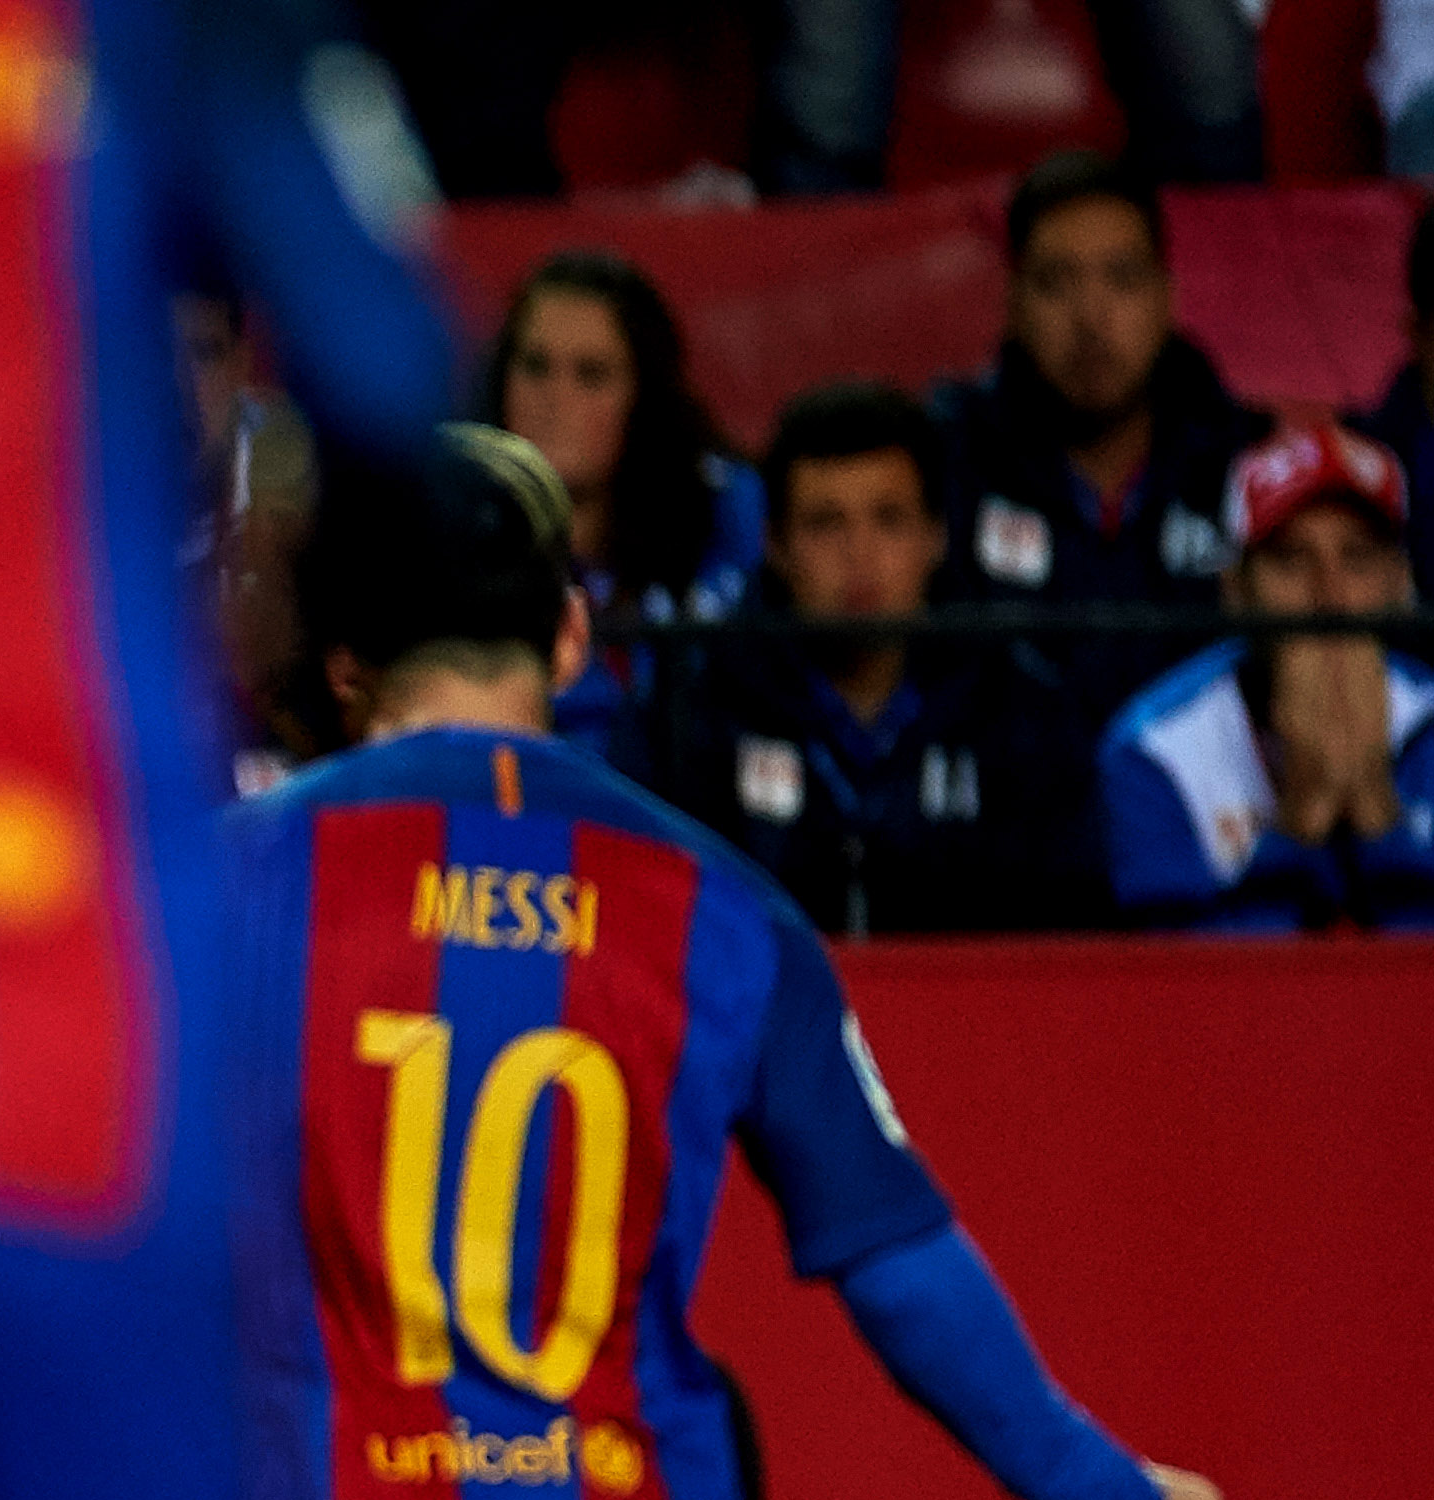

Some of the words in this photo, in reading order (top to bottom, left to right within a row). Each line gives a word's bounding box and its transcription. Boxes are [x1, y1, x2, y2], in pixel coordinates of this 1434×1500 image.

[412, 862, 598, 958] MESSI
[353, 1008, 630, 1402] 10
[365, 1414, 577, 1486] unicef
